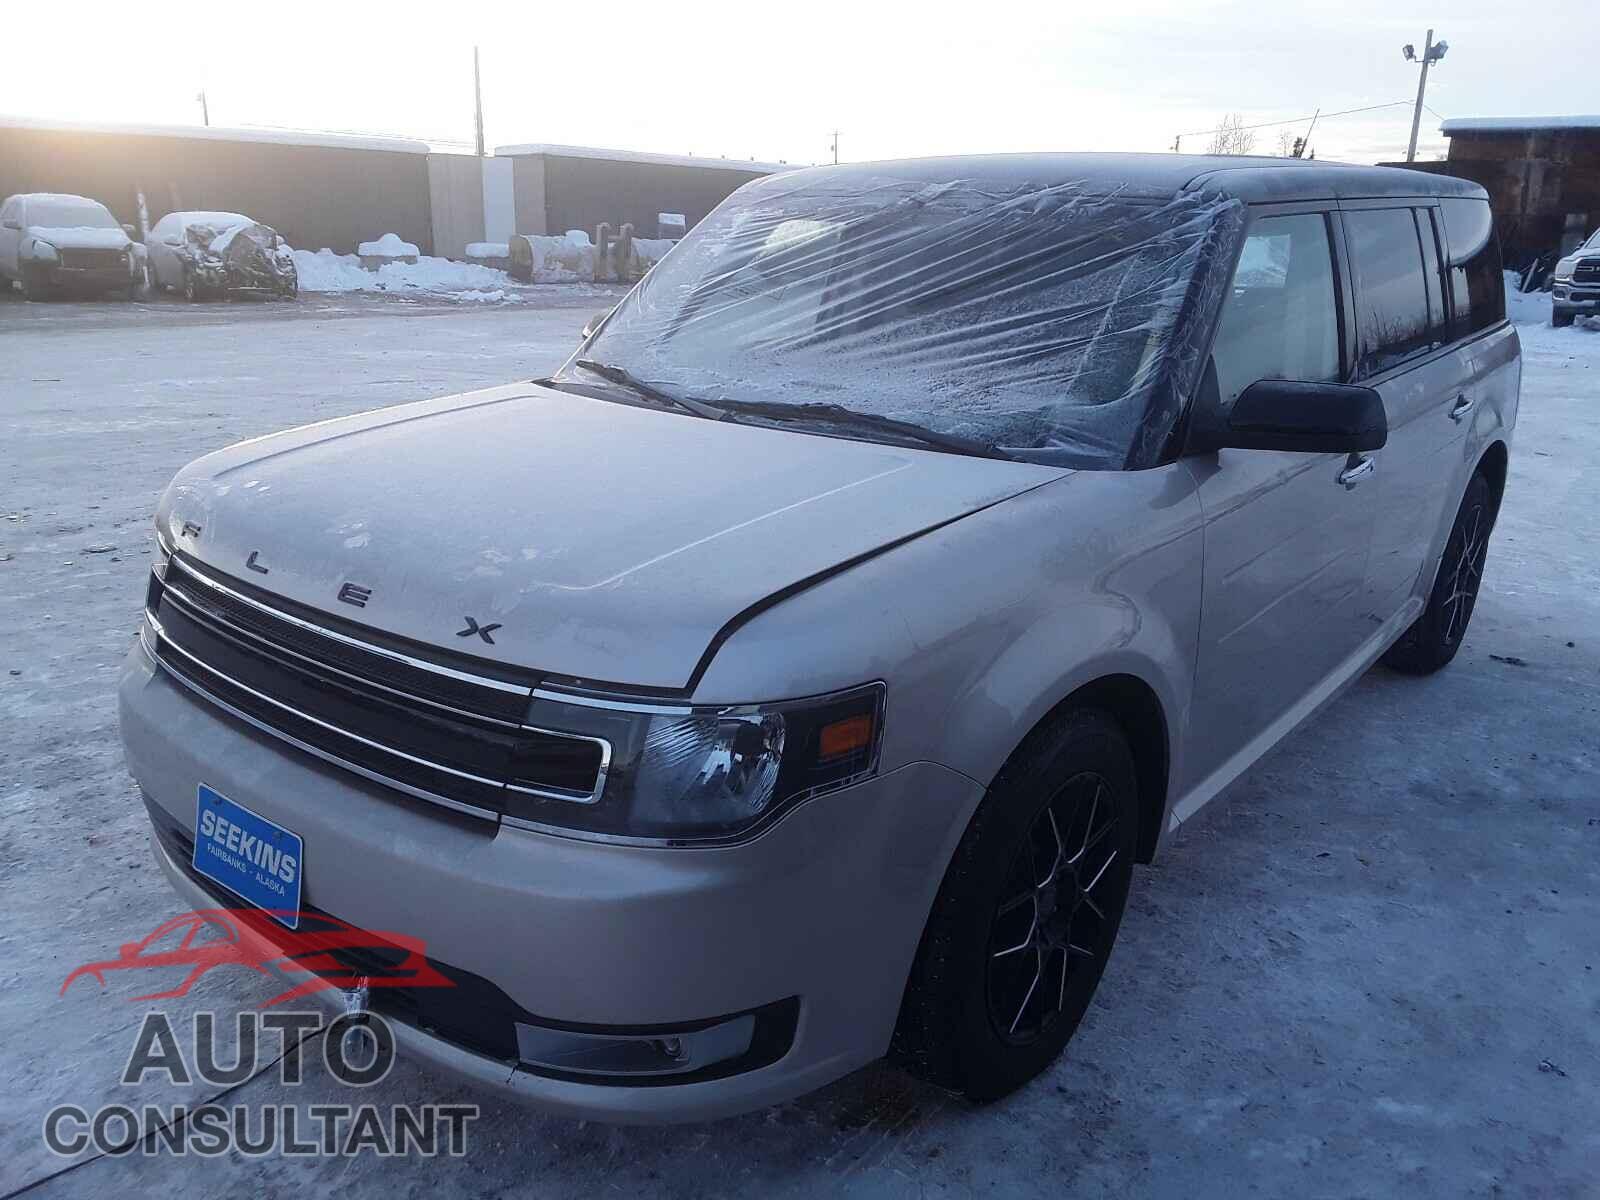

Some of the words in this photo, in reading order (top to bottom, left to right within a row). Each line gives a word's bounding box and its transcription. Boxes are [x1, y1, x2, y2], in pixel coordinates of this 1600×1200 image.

[200, 809, 297, 883] SEEKINS
[207, 843, 247, 873] FAIRBANKS
[256, 872, 285, 897] ALASKA
